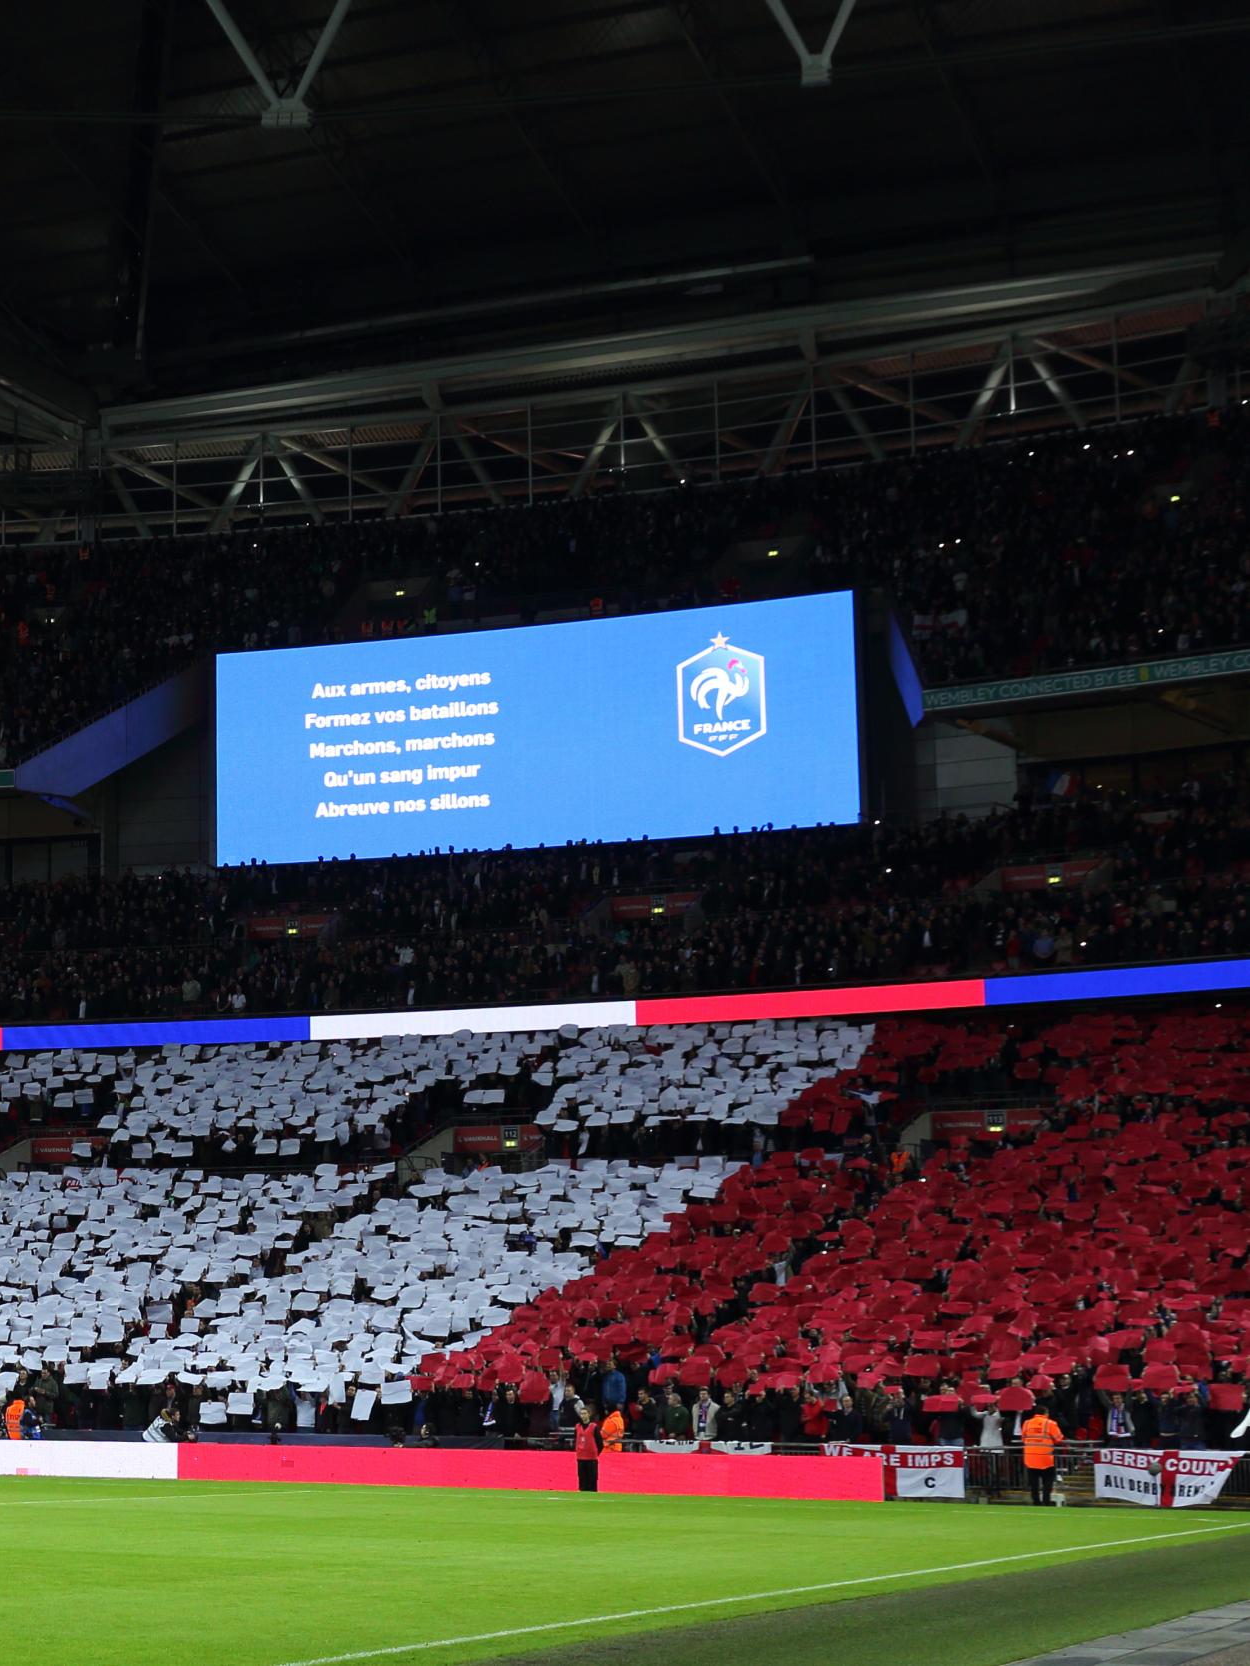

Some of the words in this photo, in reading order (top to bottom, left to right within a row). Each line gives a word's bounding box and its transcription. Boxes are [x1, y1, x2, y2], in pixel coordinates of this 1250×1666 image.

[312, 683, 346, 699] Aux
[350, 680, 411, 696] armes,
[415, 672, 491, 691] citoyens
[305, 713, 370, 729] Formez
[375, 710, 406, 723] vos
[410, 701, 499, 721] bataillons
[693, 719, 751, 735] FRANCE
[310, 740, 401, 758] Marchons,
[405, 732, 495, 752] marchons
[324, 770, 376, 787] Qu'un
[380, 769, 423, 785] sang
[427, 764, 481, 782] impur
[315, 802, 390, 818] Abreuve
[393, 799, 426, 813] nos
[430, 794, 490, 811] sillons
[504, 1130, 517, 1138] 112
[907, 1453, 954, 1466] IMPS
[925, 1477, 936, 1489] C
[1104, 1475, 1124, 1489] ALL
